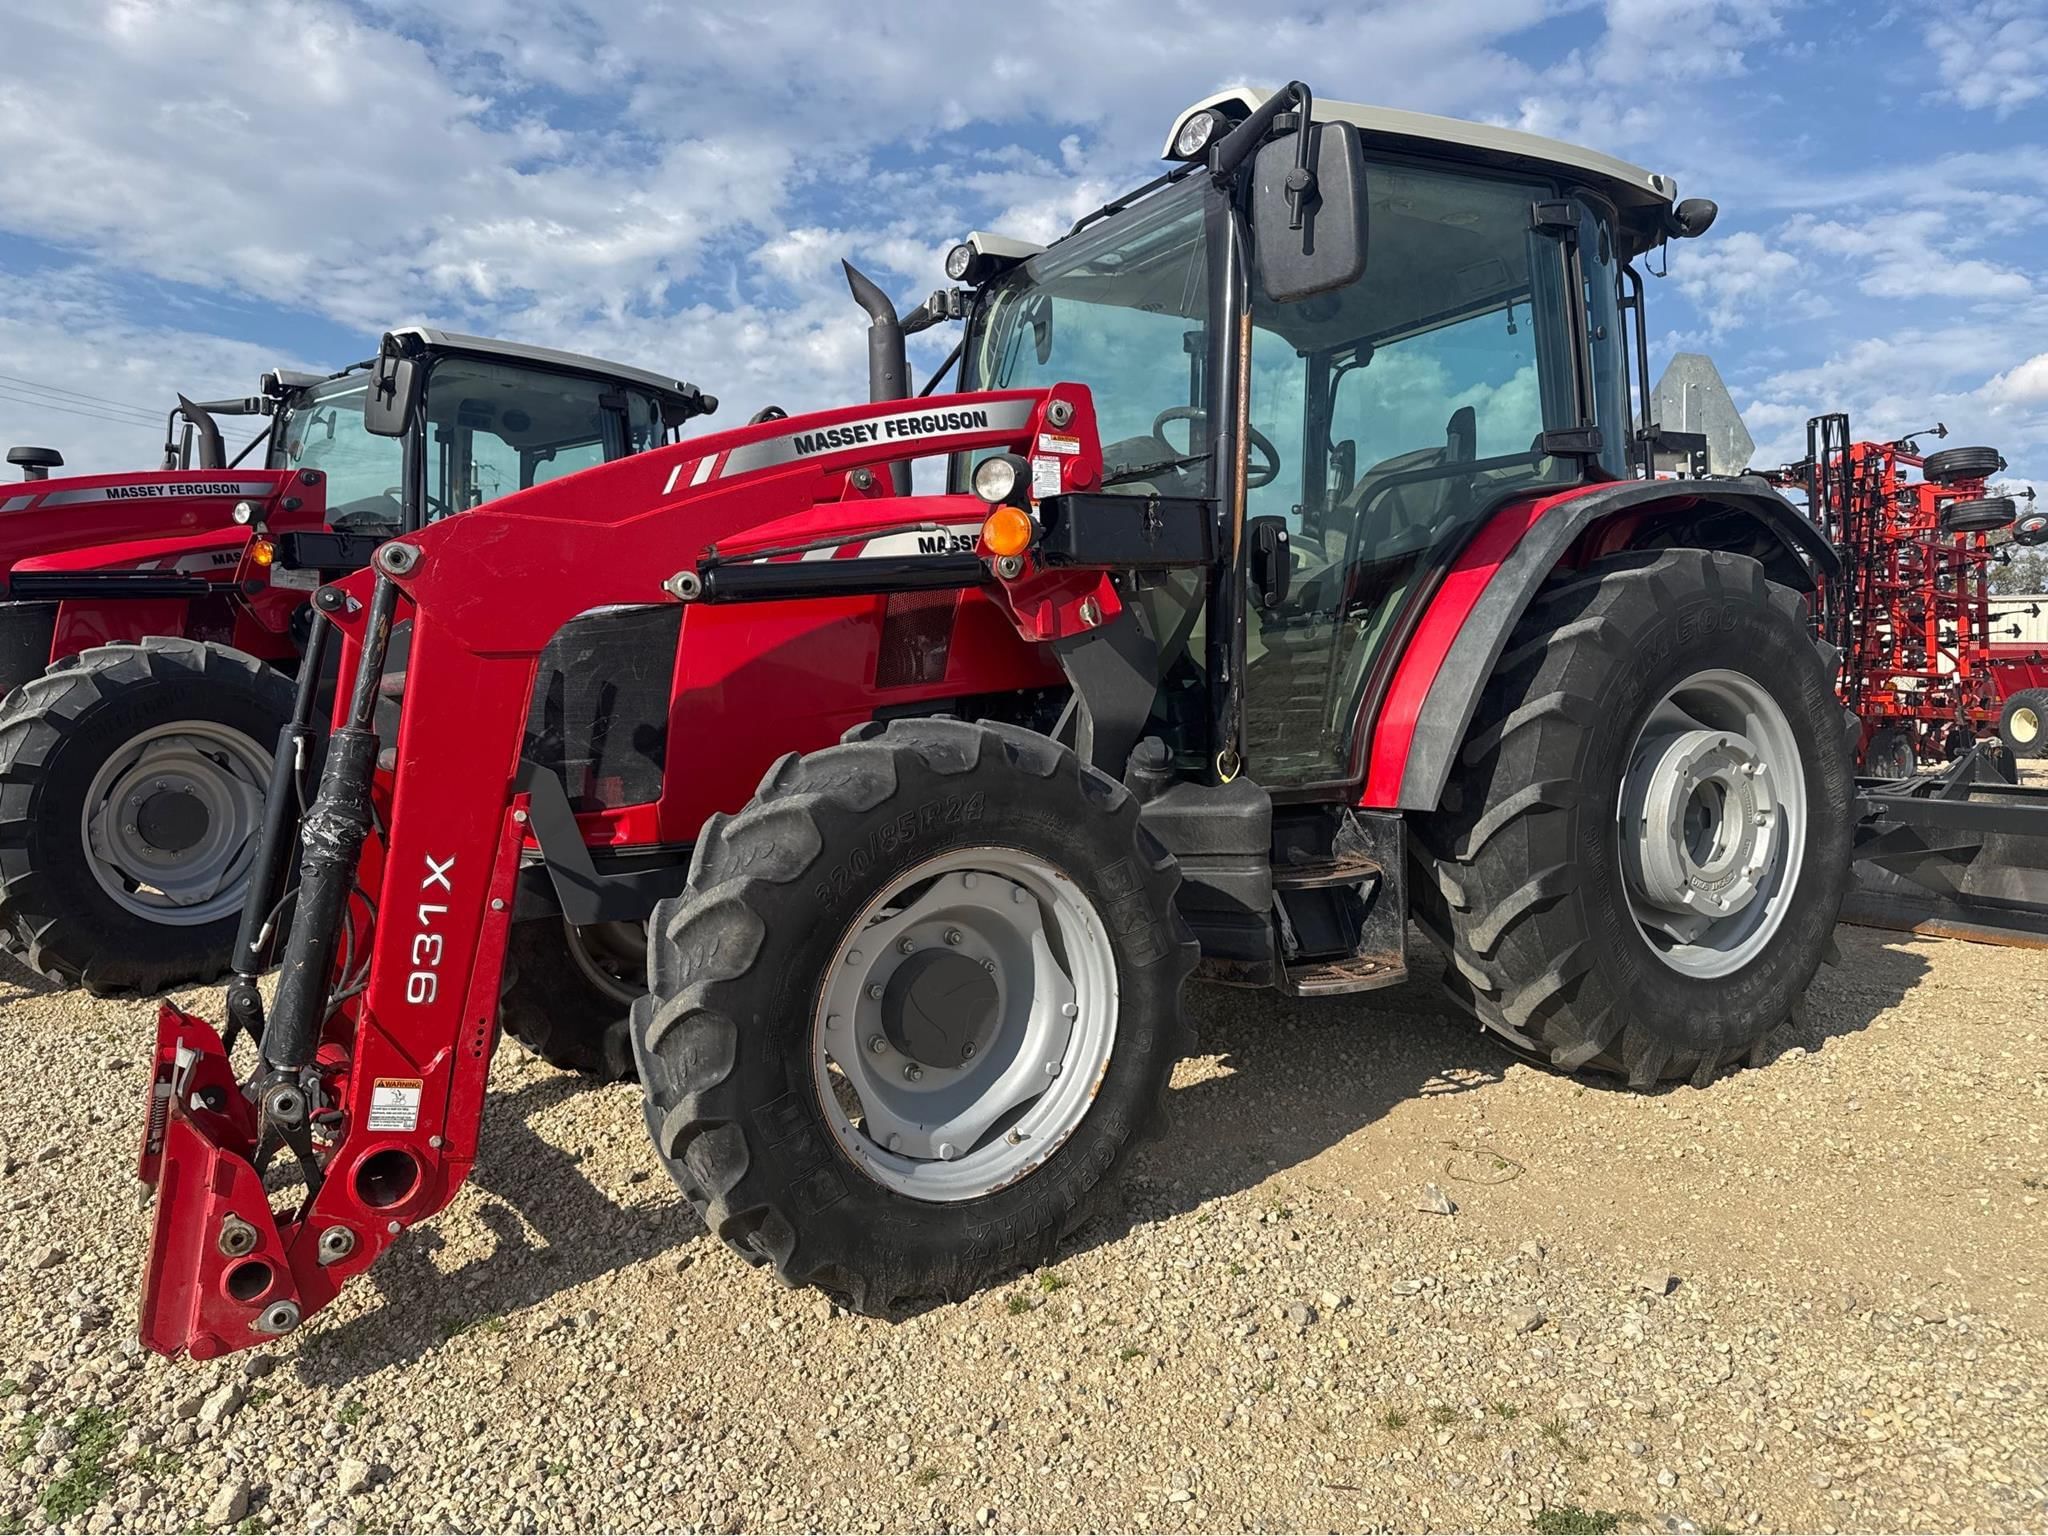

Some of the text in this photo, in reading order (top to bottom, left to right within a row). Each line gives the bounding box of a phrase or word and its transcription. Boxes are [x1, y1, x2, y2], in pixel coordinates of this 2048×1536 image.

[793, 411, 988, 455] MASSEY FERGUSON
[105, 484, 241, 500] MASSEY FERGUSON
